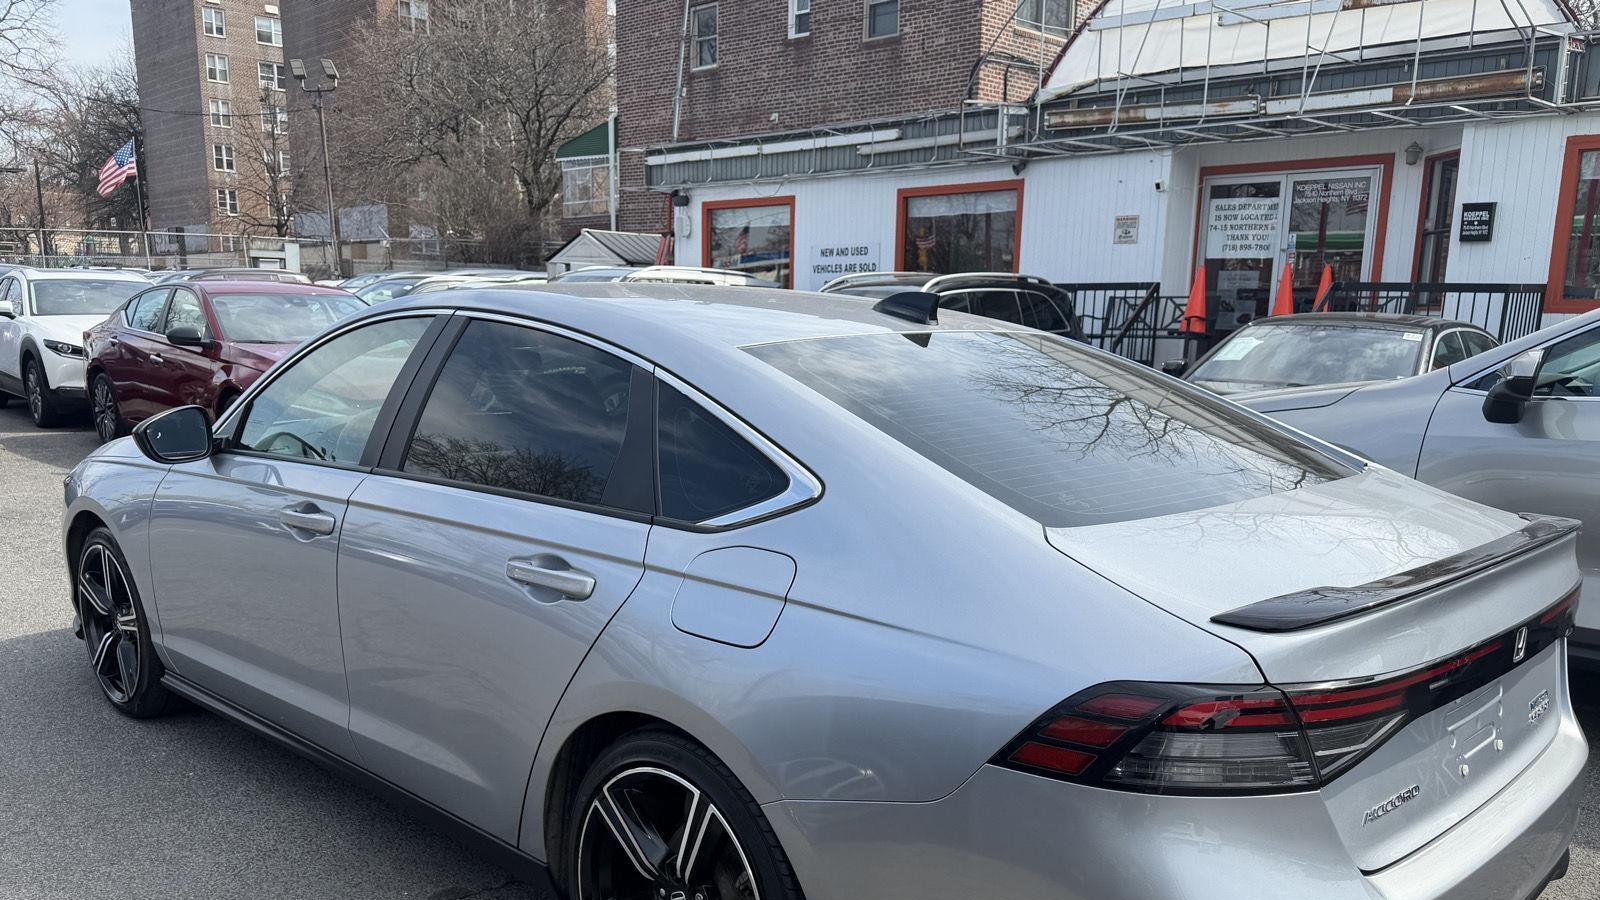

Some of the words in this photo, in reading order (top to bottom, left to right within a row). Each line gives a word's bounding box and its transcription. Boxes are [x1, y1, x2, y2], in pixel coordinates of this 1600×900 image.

[1296, 183, 1326, 191] KOEPPEL
[820, 248, 834, 257] NEW
[836, 247, 849, 256] AND
[850, 246, 868, 256] USED
[812, 264, 842, 274] VEHICLES
[844, 263, 857, 272] ARE
[859, 262, 876, 272] SOLD
[1362, 785, 1420, 828] ACCORD
